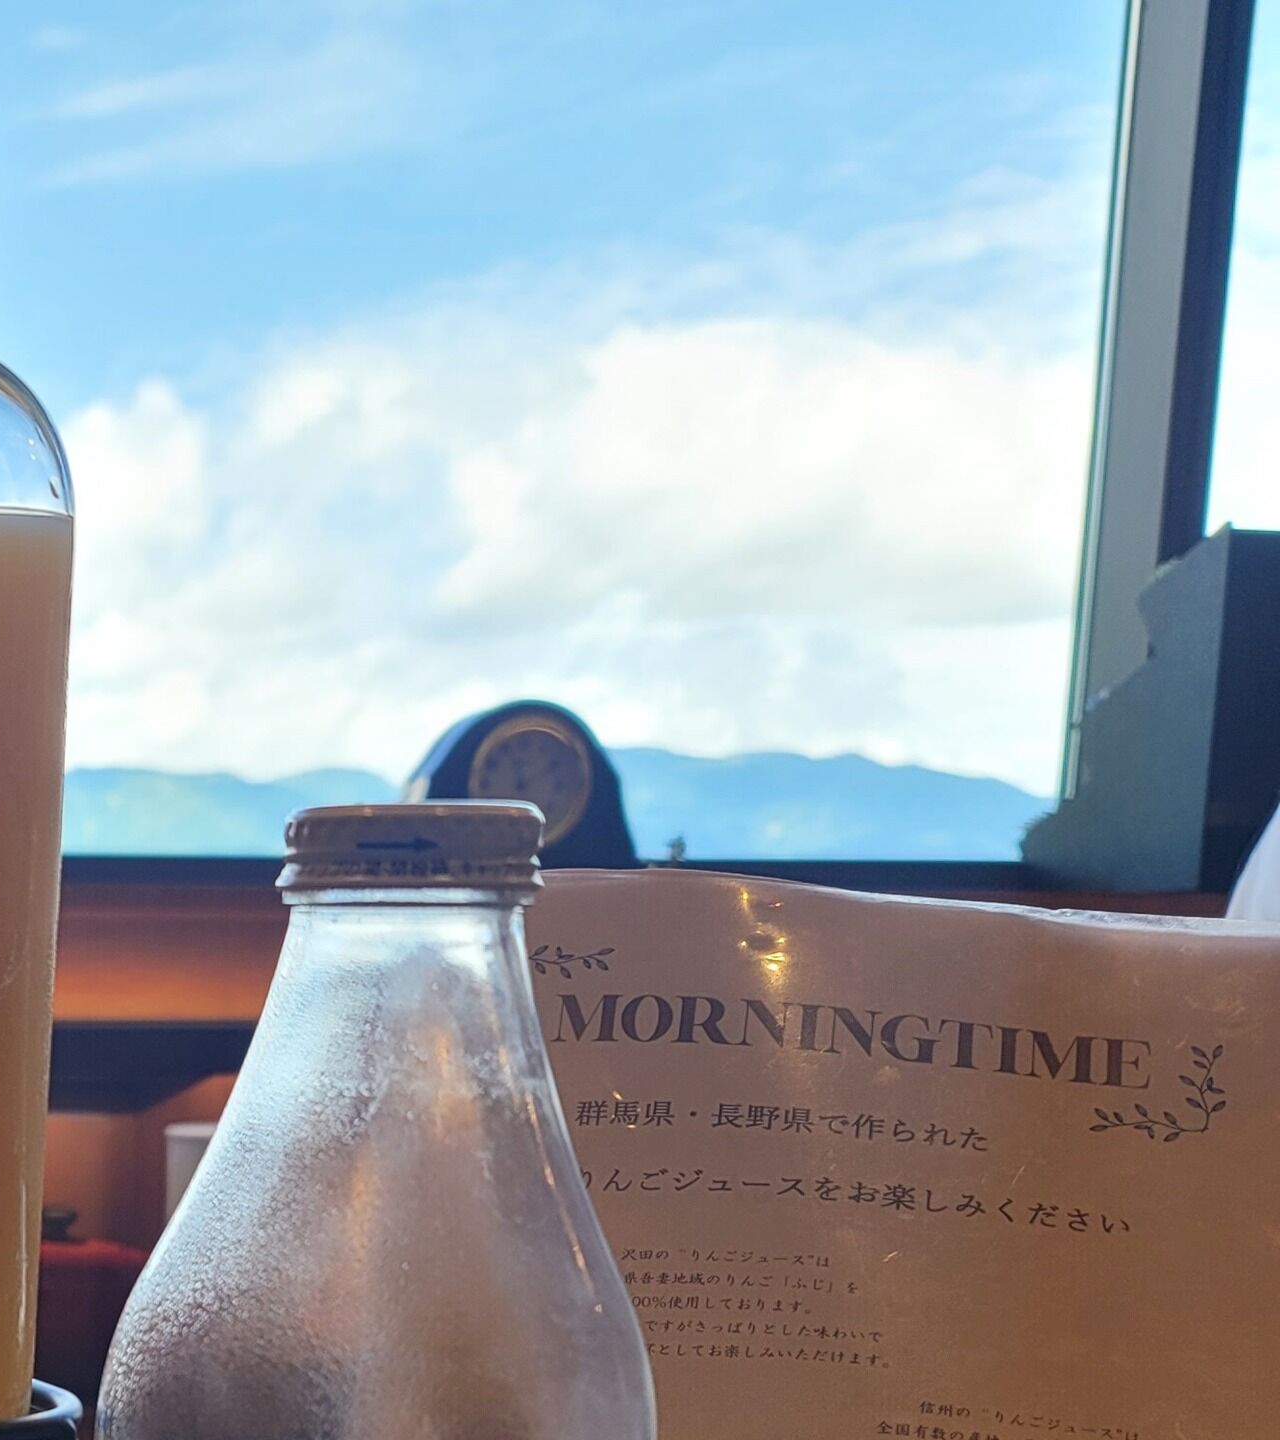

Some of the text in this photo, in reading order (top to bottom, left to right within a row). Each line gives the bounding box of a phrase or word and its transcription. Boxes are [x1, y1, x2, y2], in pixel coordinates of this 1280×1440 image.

[551, 993, 1152, 1090] MORNINGTIME
[575, 1099, 988, 1152] 群馬県・長野県で作られた
[580, 1167, 1131, 1234] りんごジュースをお楽しみください
